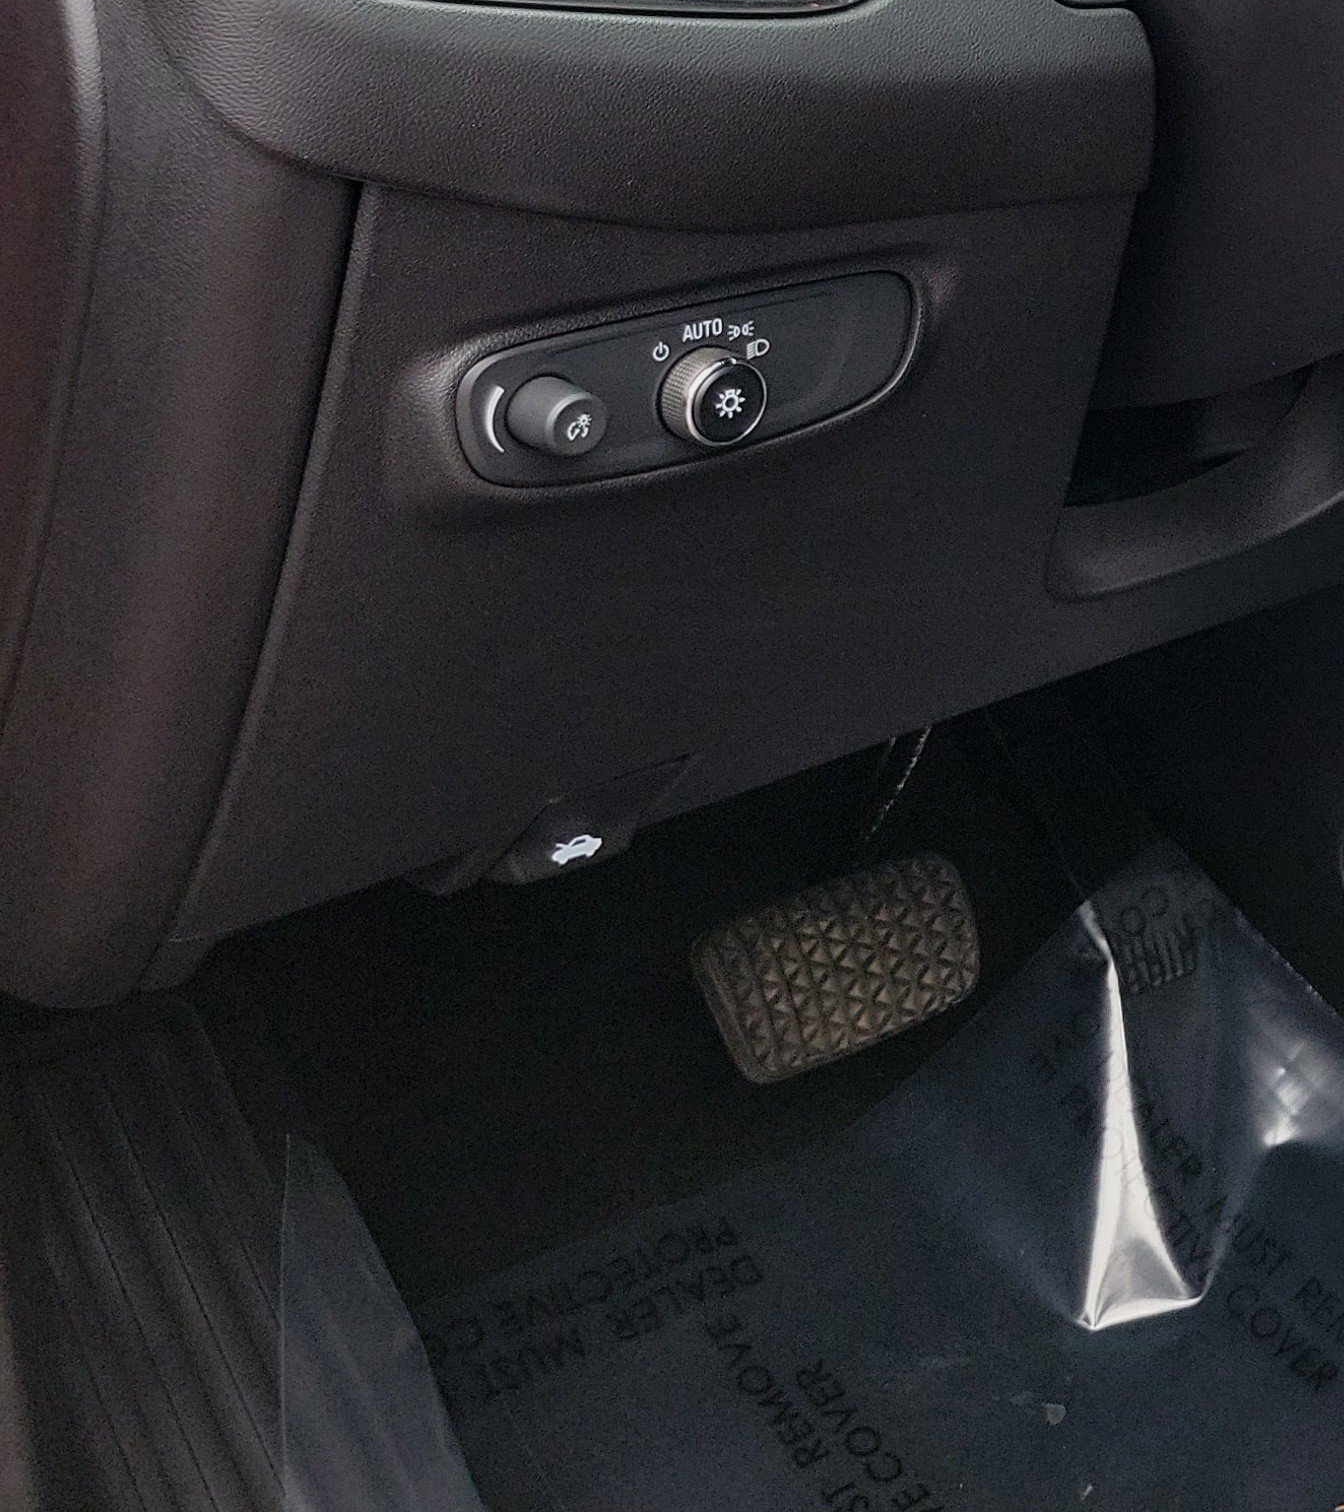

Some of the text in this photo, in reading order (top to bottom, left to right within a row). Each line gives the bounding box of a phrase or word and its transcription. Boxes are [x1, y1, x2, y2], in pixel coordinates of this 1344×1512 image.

[682, 317, 723, 343] AUTO
[1225, 1284, 1339, 1390] COVER
[795, 1357, 904, 1486] COVER
